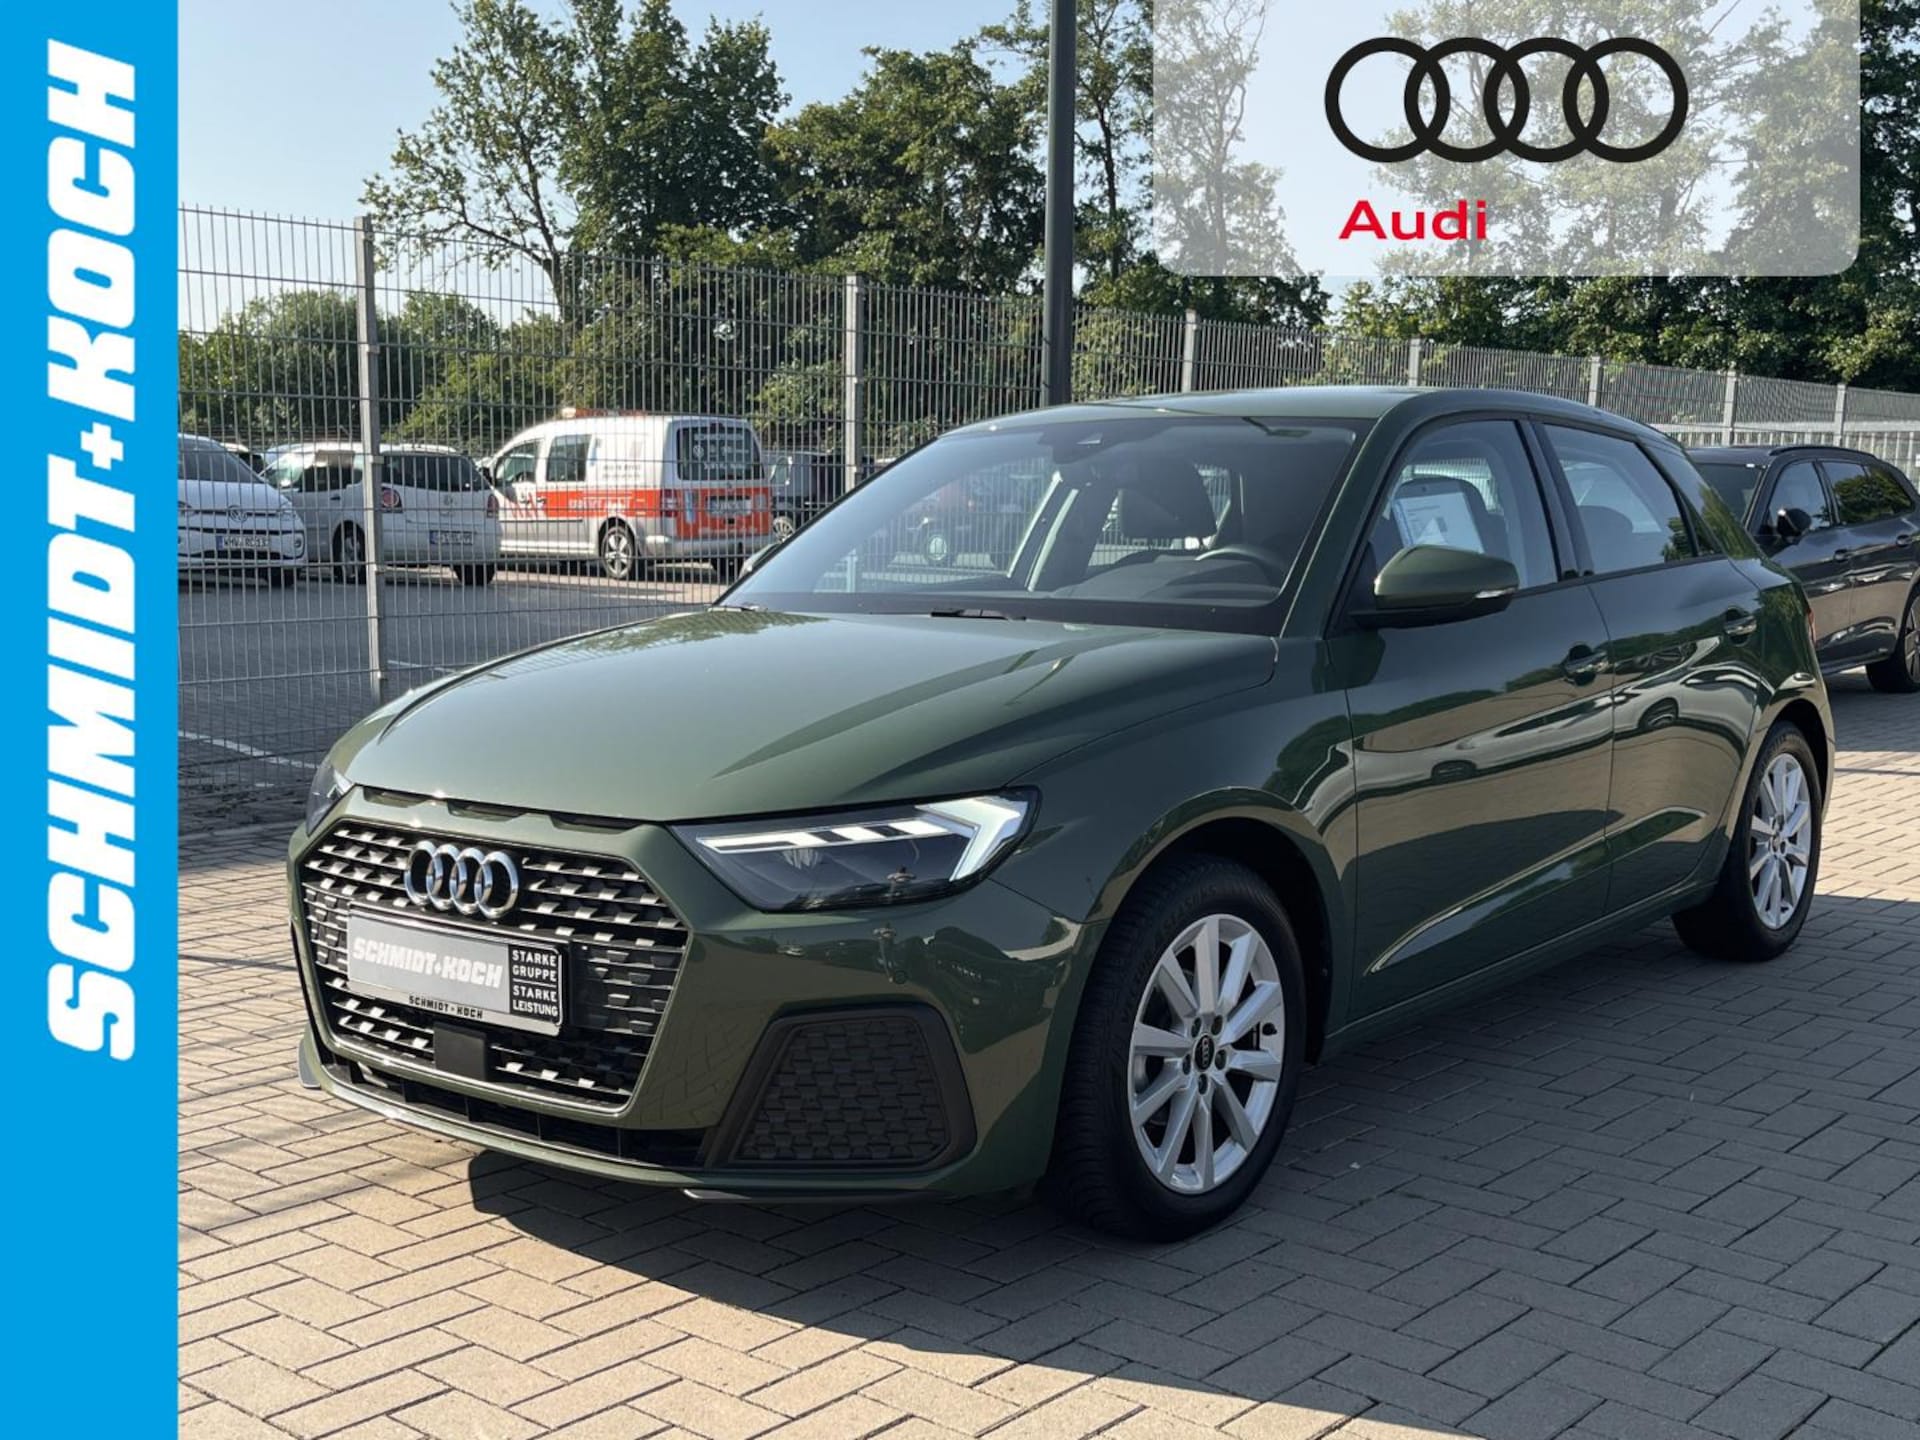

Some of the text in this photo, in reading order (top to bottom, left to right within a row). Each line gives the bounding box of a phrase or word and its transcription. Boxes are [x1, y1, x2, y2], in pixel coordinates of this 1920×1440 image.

[352, 937, 503, 988] SCHMIDT+KOCH
[512, 949, 557, 967] STARKE
[512, 965, 557, 982] GRUPPE
[512, 985, 557, 1002] STARKE
[512, 1000, 559, 1017] LEISTUNG
